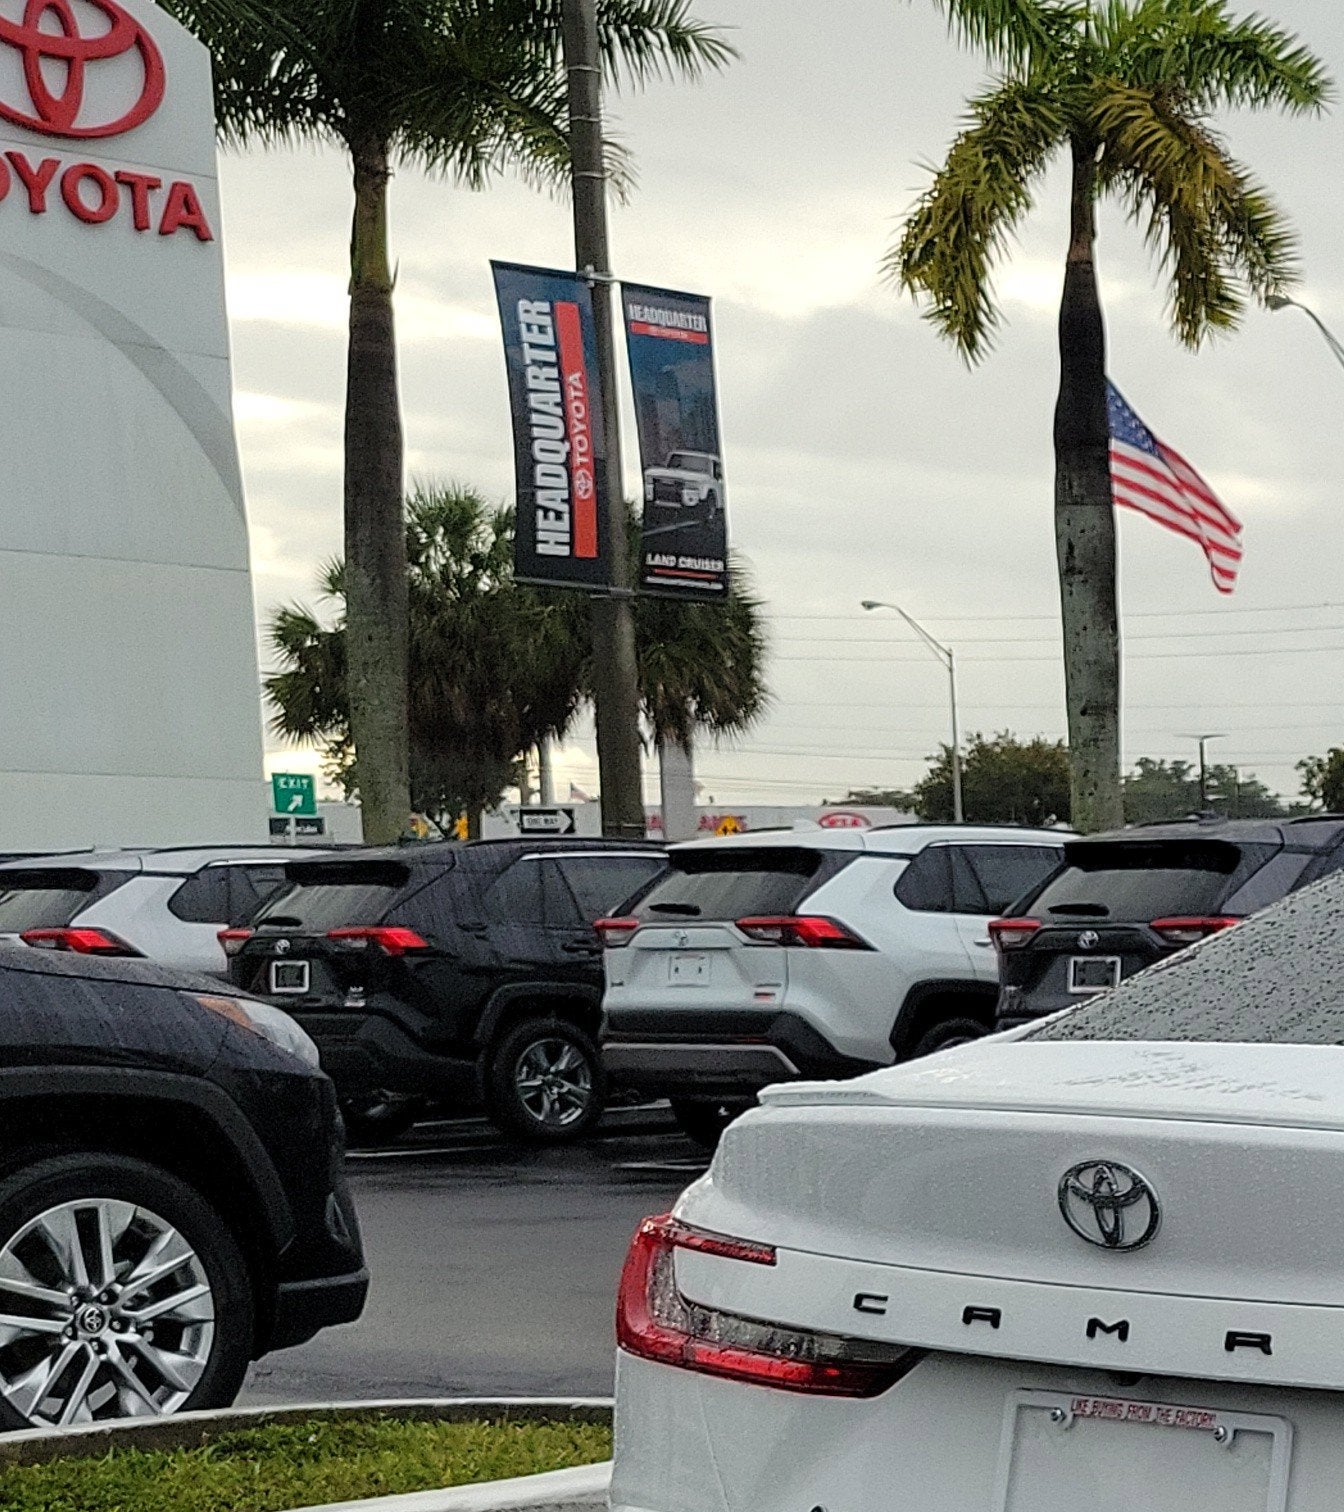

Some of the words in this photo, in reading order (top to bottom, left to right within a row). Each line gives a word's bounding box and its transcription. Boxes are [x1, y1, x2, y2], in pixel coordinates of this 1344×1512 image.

[0, 151, 214, 242] YOTA
[628, 303, 707, 332] HEADQUARTER
[518, 298, 571, 557] HEADQUARTER
[567, 371, 590, 467] TOYOTA
[645, 553, 677, 567] LAND
[278, 777, 308, 790] EXIT
